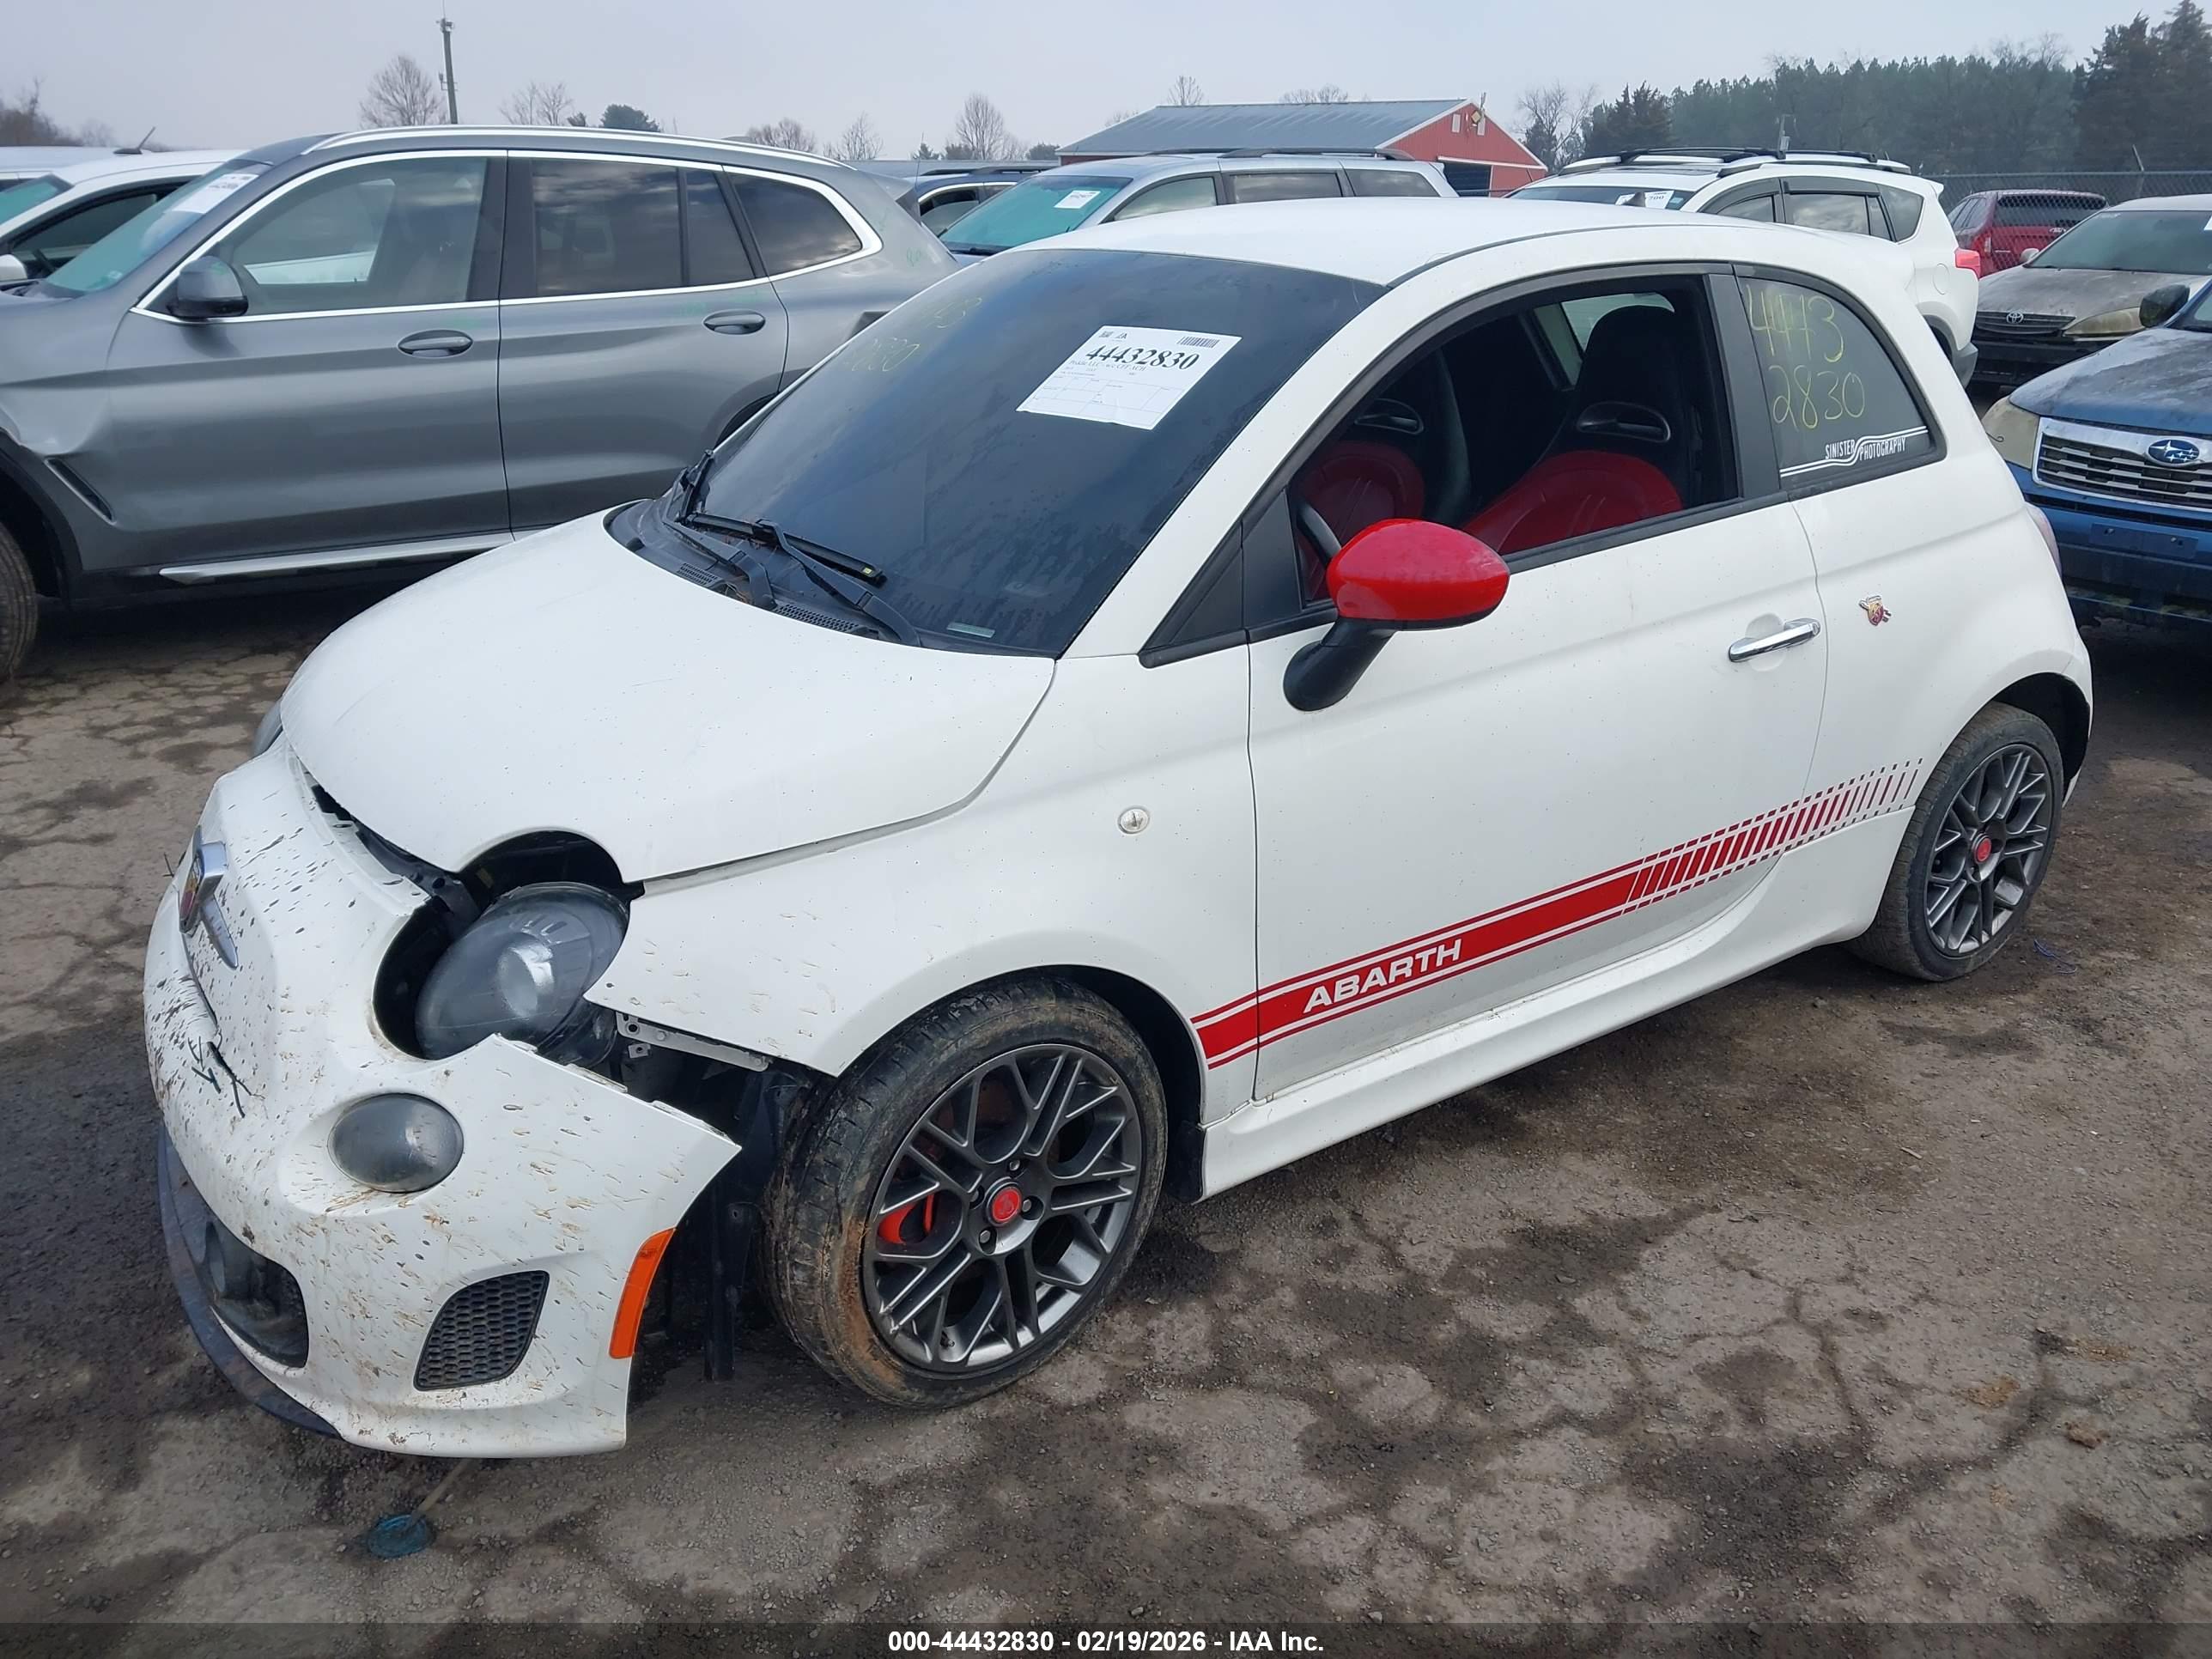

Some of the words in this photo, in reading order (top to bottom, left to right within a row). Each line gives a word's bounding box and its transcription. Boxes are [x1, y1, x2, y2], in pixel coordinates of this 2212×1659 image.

[1085, 344, 1200, 370] 44432830
[1746, 283, 1844, 363] 4443
[1768, 364, 1866, 432] 2830
[1825, 439, 1856, 460] SINISTER
[1859, 436, 1906, 461] PHOTOGRAPHY
[1303, 939, 1462, 1014] ABARTH
